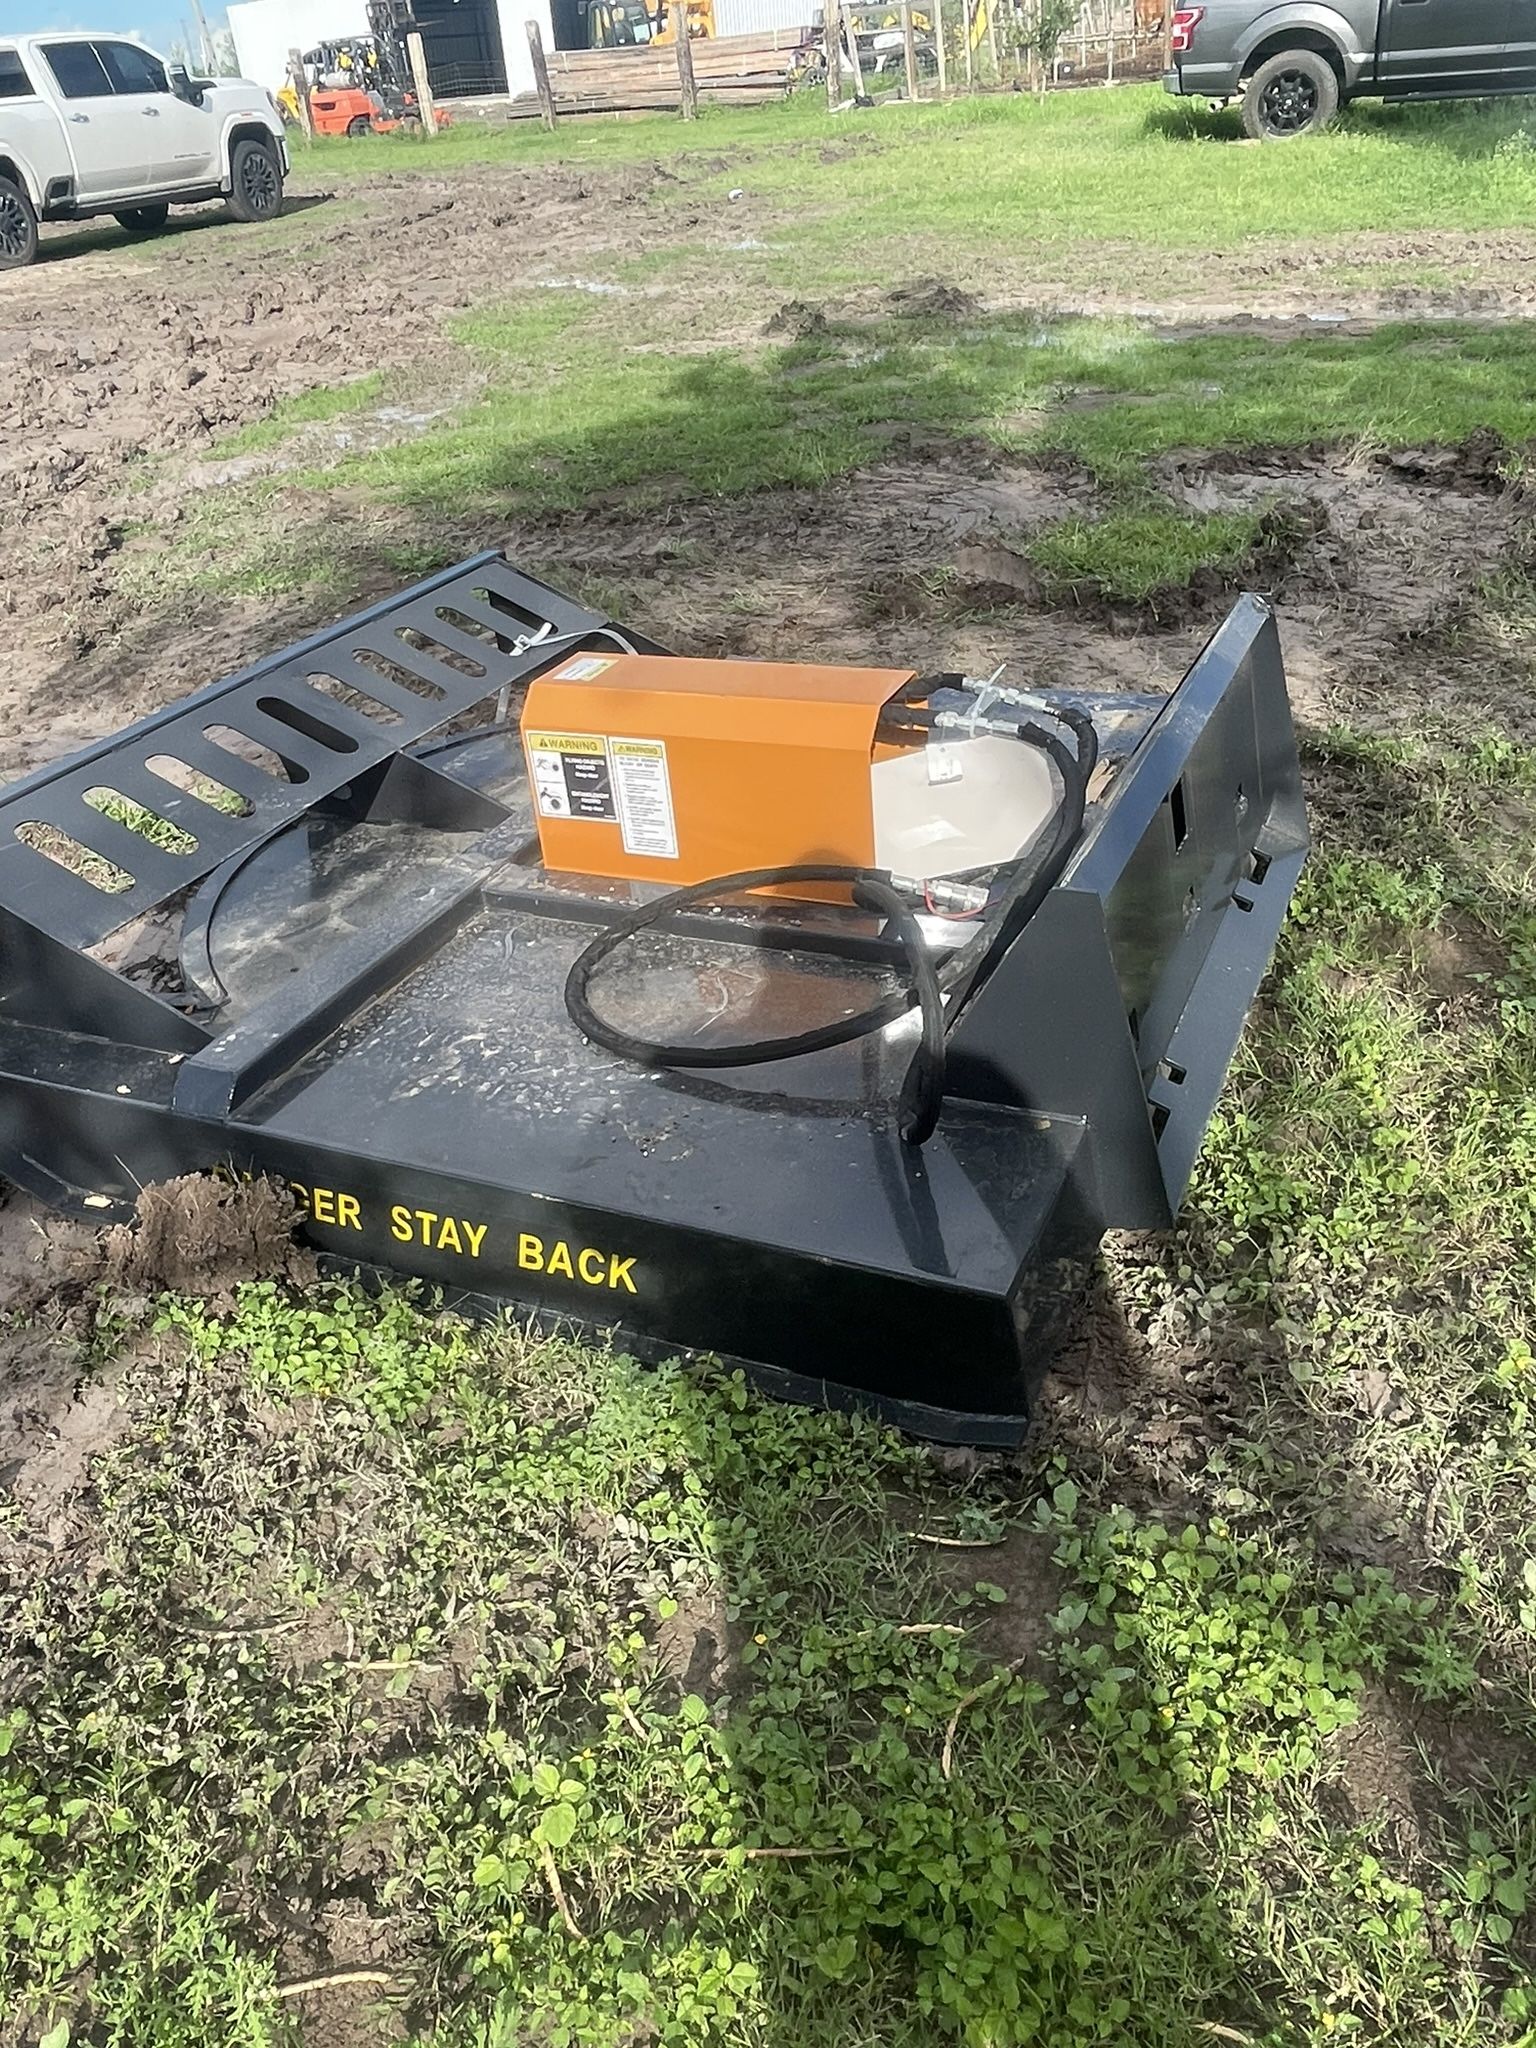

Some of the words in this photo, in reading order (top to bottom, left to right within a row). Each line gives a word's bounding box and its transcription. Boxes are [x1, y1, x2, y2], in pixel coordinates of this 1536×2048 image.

[549, 738, 598, 751] WARNING
[391, 1205, 488, 1257] STAY
[517, 1232, 638, 1294] BACK
